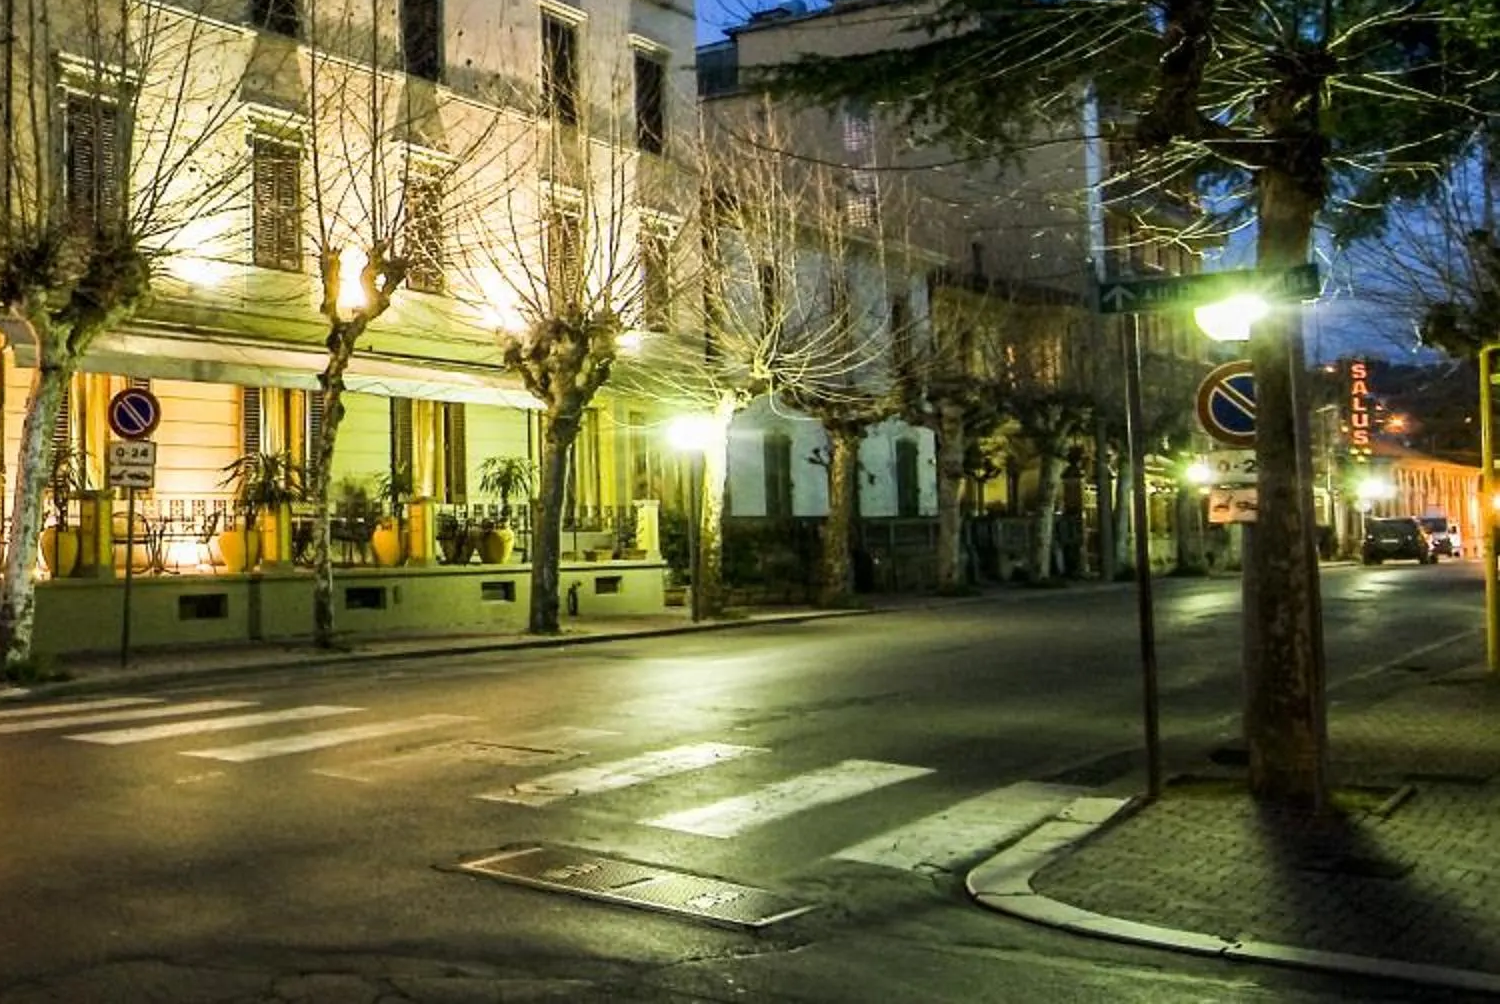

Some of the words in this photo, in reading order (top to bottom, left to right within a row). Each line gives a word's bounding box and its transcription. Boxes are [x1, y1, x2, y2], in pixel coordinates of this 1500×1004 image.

[1350, 362, 1369, 445] SALUS
[115, 447, 149, 458] 0-24
[1217, 459, 1258, 474] 0-2
